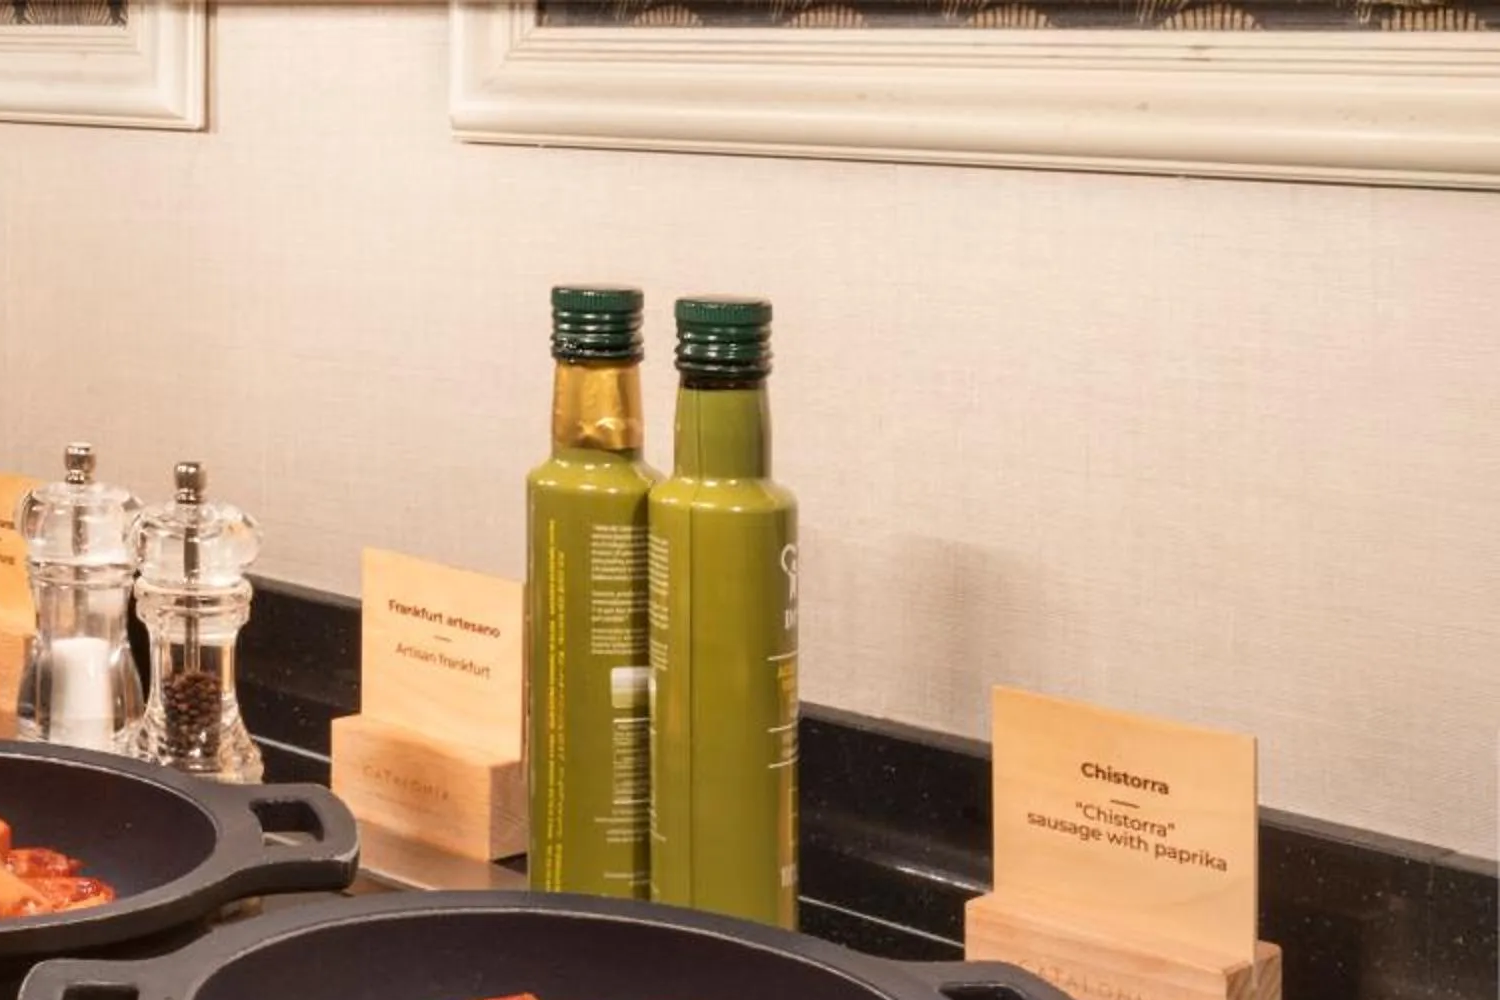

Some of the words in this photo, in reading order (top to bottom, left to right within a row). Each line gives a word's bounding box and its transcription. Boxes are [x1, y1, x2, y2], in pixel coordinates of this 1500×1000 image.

[388, 599, 443, 625] Frankfurt
[446, 615, 501, 639] artesano
[395, 642, 437, 663] Artisan
[438, 652, 492, 680] frankfurt
[1080, 761, 1170, 796] Chistorra
[1075, 800, 1176, 838] "Chistorra"
[1027, 811, 1104, 841] sausage
[1106, 829, 1150, 853] with
[1154, 841, 1228, 872] paprika
